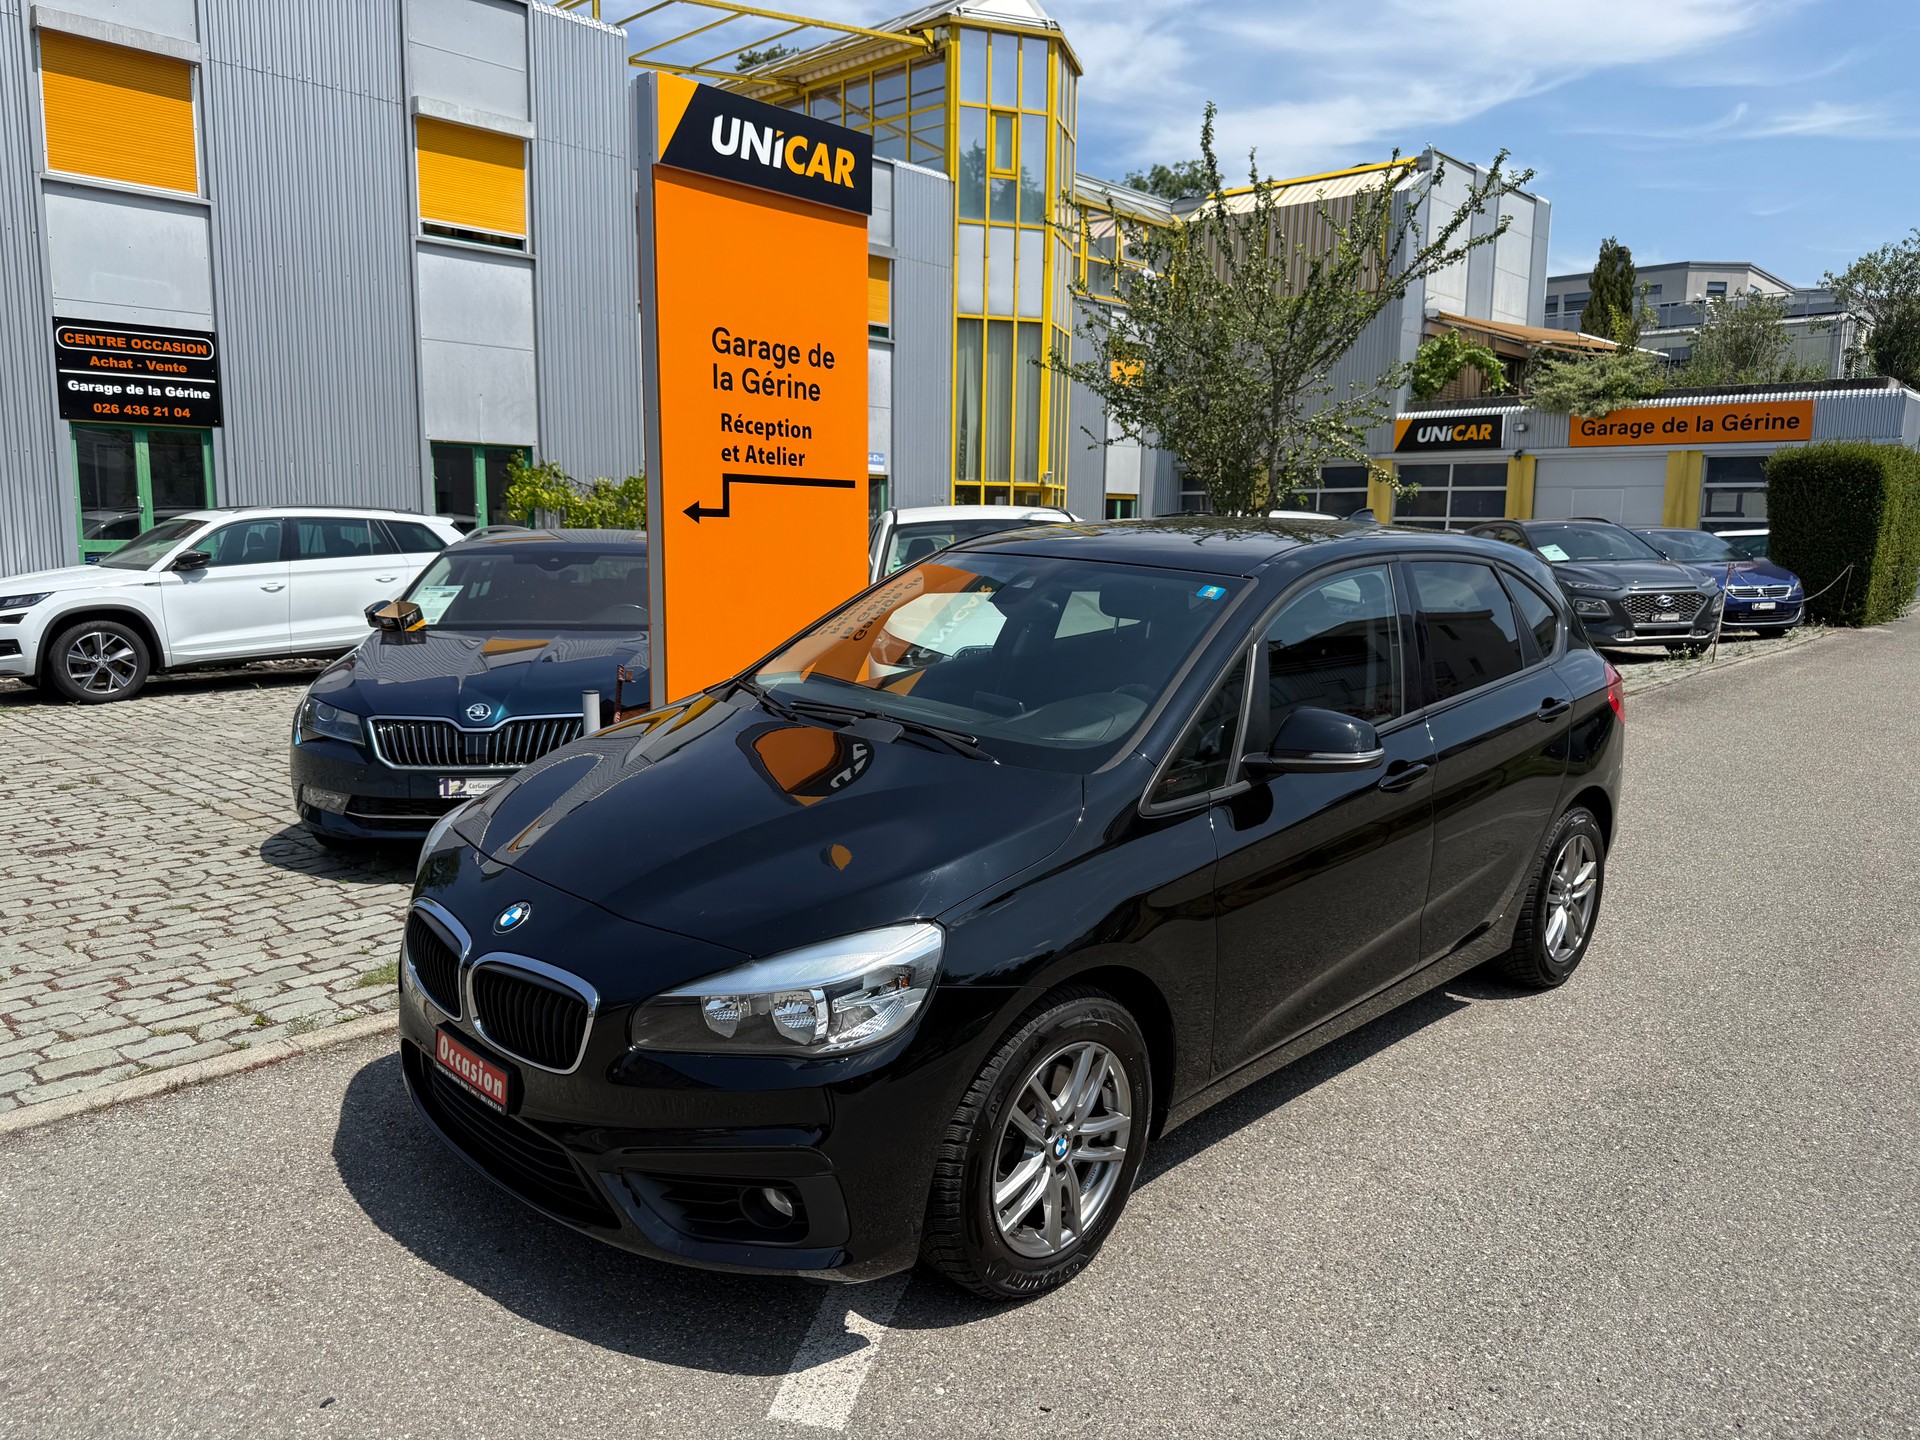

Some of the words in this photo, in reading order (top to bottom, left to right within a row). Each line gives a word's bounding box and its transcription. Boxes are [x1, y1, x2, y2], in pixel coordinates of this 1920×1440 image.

[63, 332, 127, 348] CENTRE
[131, 338, 207, 355] OCCASION
[711, 326, 801, 369] Garage
[808, 343, 836, 370] de
[89, 355, 133, 369] Achat
[146, 360, 187, 373] Vente
[67, 380, 122, 395] Garage
[126, 384, 144, 395] de
[148, 385, 161, 396] la
[165, 386, 211, 399] Gérine
[713, 362, 734, 391] la
[741, 367, 821, 402] Gérine
[93, 403, 120, 414] 026
[124, 404, 149, 416] 436
[153, 406, 169, 417] 21
[174, 407, 191, 418] 04
[721, 413, 812, 441] Réception
[1581, 419, 1655, 439] Garage
[1662, 416, 1688, 433] de
[1695, 415, 1714, 432] la
[1721, 412, 1800, 432] Gérine
[721, 445, 740, 463] et
[745, 444, 806, 467] Atelier
[440, 1035, 503, 1099] Occasion
